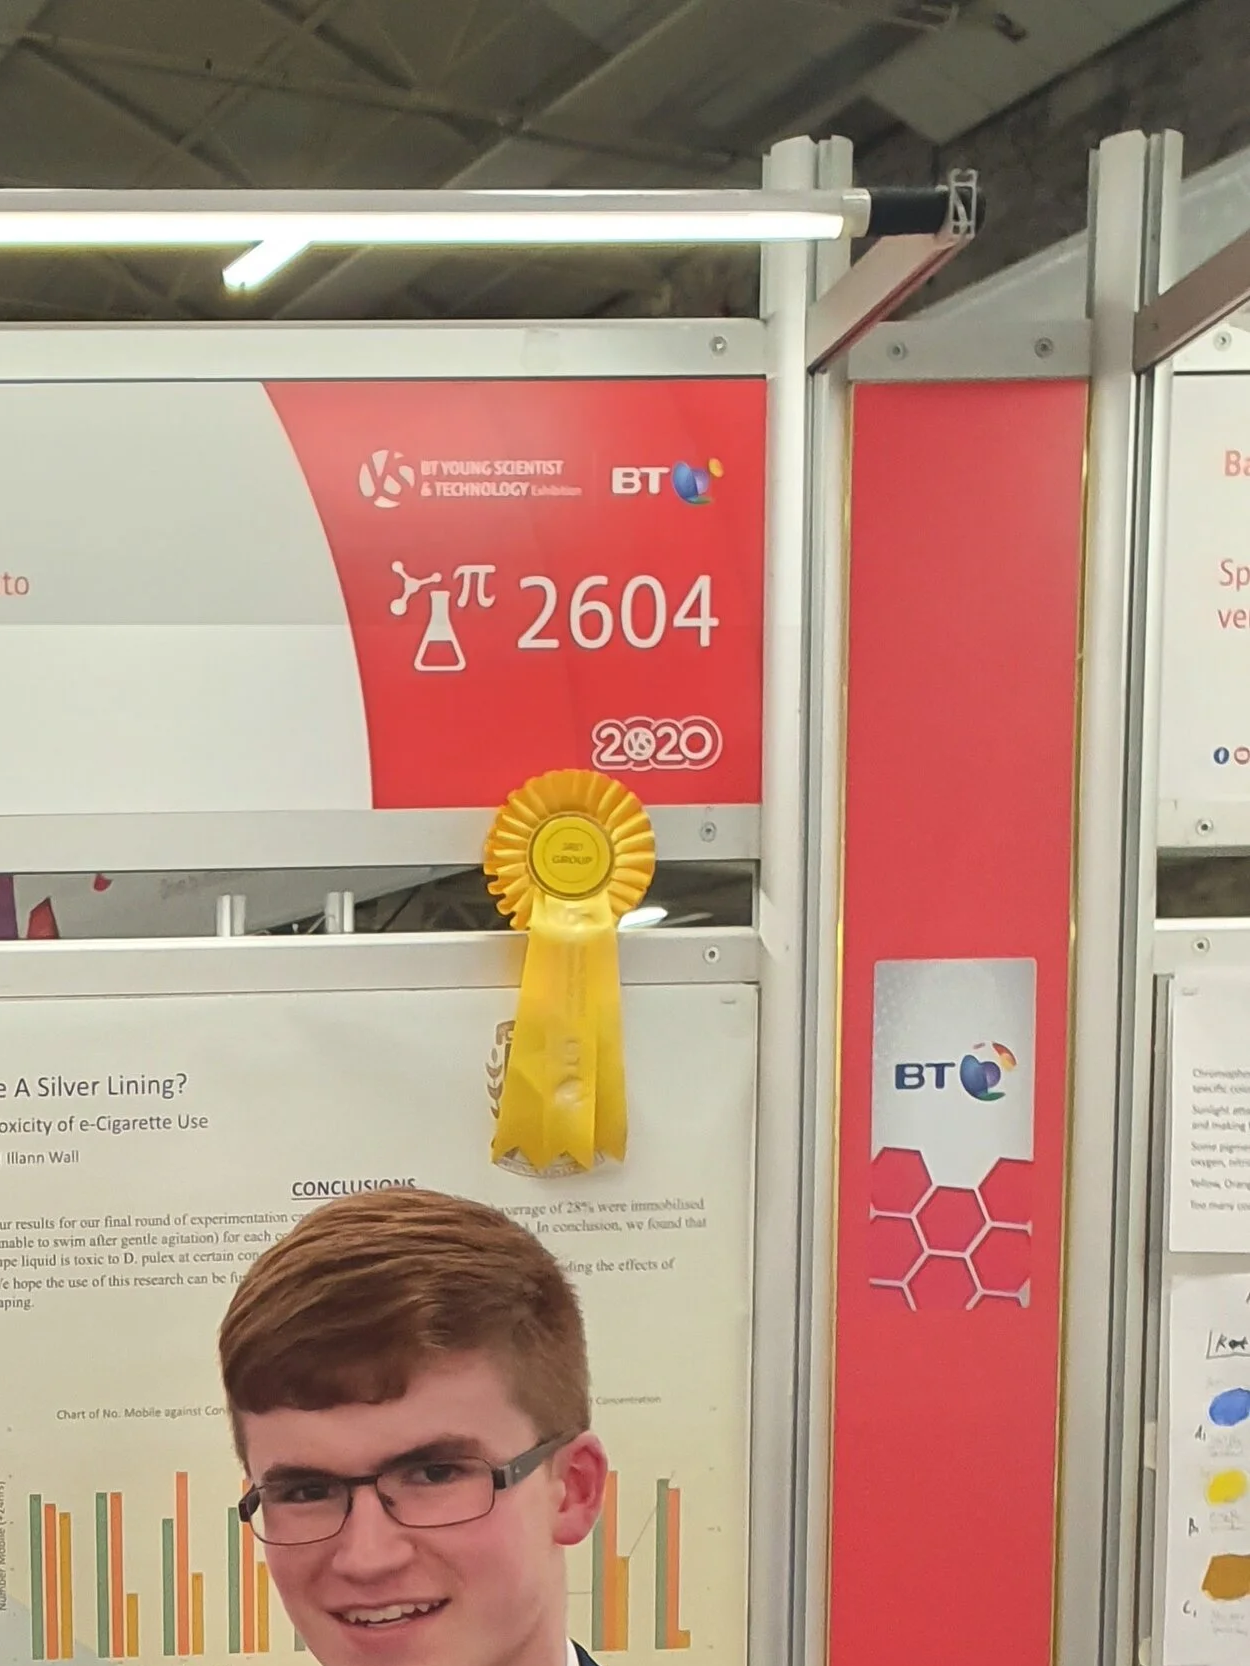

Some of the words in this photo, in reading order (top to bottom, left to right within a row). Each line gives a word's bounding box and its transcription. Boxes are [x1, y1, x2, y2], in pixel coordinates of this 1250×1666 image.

[421, 460, 440, 476] BT
[442, 460, 491, 476] YOUNG
[493, 460, 563, 476] SCIENTIST
[421, 482, 432, 497] &
[435, 481, 530, 497] TECHNOLOGY
[611, 466, 671, 495] BT
[517, 575, 719, 650] 2604
[596, 721, 718, 767] 2020
[14, 1078, 30, 1097] A
[38, 1076, 100, 1097] Silver
[108, 1073, 187, 1099] Lining?
[895, 1063, 955, 1089] BT
[58, 1116, 75, 1132] of
[80, 1116, 172, 1134] e-Cigarette
[178, 1114, 208, 1129] Use
[49, 1150, 78, 1163] Wall
[16, 1217, 55, 1230] results
[59, 1217, 77, 1228] for
[80, 1219, 100, 1228] our
[105, 1215, 131, 1228] final
[135, 1214, 170, 1227] round
[174, 1213, 188, 1225] of
[190, 1214, 288, 1228] experimentation
[57, 1410, 85, 1420] Chart
[89, 1408, 100, 1419] of
[103, 1409, 121, 1418] No.
[124, 1407, 161, 1417] Mobile
[165, 1408, 201, 1419] against
